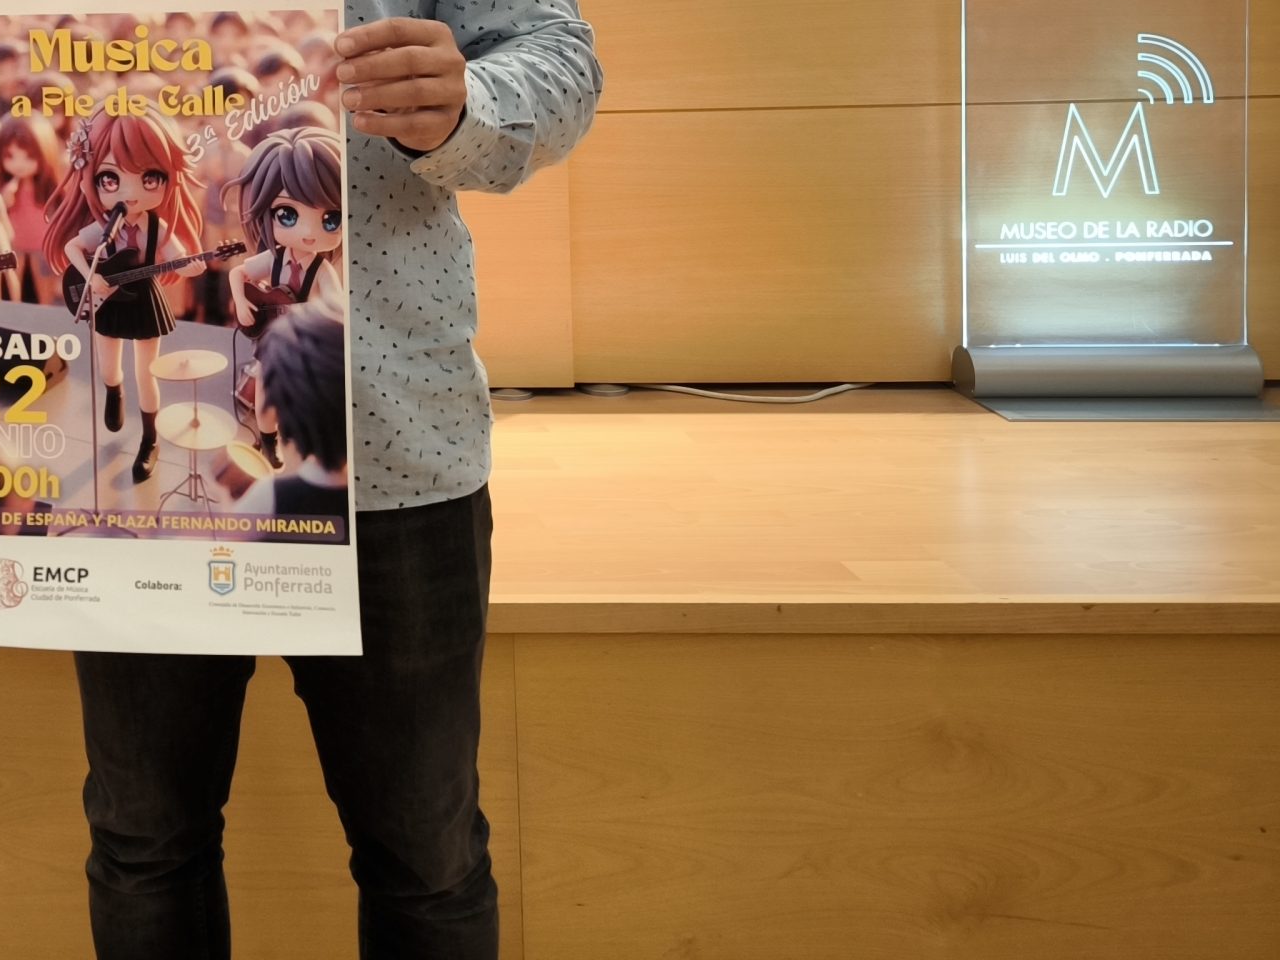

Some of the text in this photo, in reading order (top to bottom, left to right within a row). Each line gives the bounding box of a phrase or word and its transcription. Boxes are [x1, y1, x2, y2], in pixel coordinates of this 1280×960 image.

[11, 85, 245, 118] a Pie de Calle
[224, 73, 320, 141] Edición
[999, 219, 1214, 240] MUSEO DE LA RADIO
[999, 252, 1028, 264] LUIS
[1032, 251, 1056, 263] DEL
[1059, 251, 1101, 263] OLMO
[1114, 250, 1213, 263] PONFERRADA
[1, 512, 23, 525] DE
[26, 511, 88, 527] ESPAÑA
[92, 515, 103, 527] Y
[107, 515, 157, 529] PLAZA
[161, 516, 252, 532] FERNANDO
[256, 519, 336, 535] MIRANDA
[32, 566, 89, 584] EMCP
[243, 562, 332, 577] Ayuntamiento
[134, 580, 182, 591] Colabora:
[243, 577, 333, 597] Ponferrada
